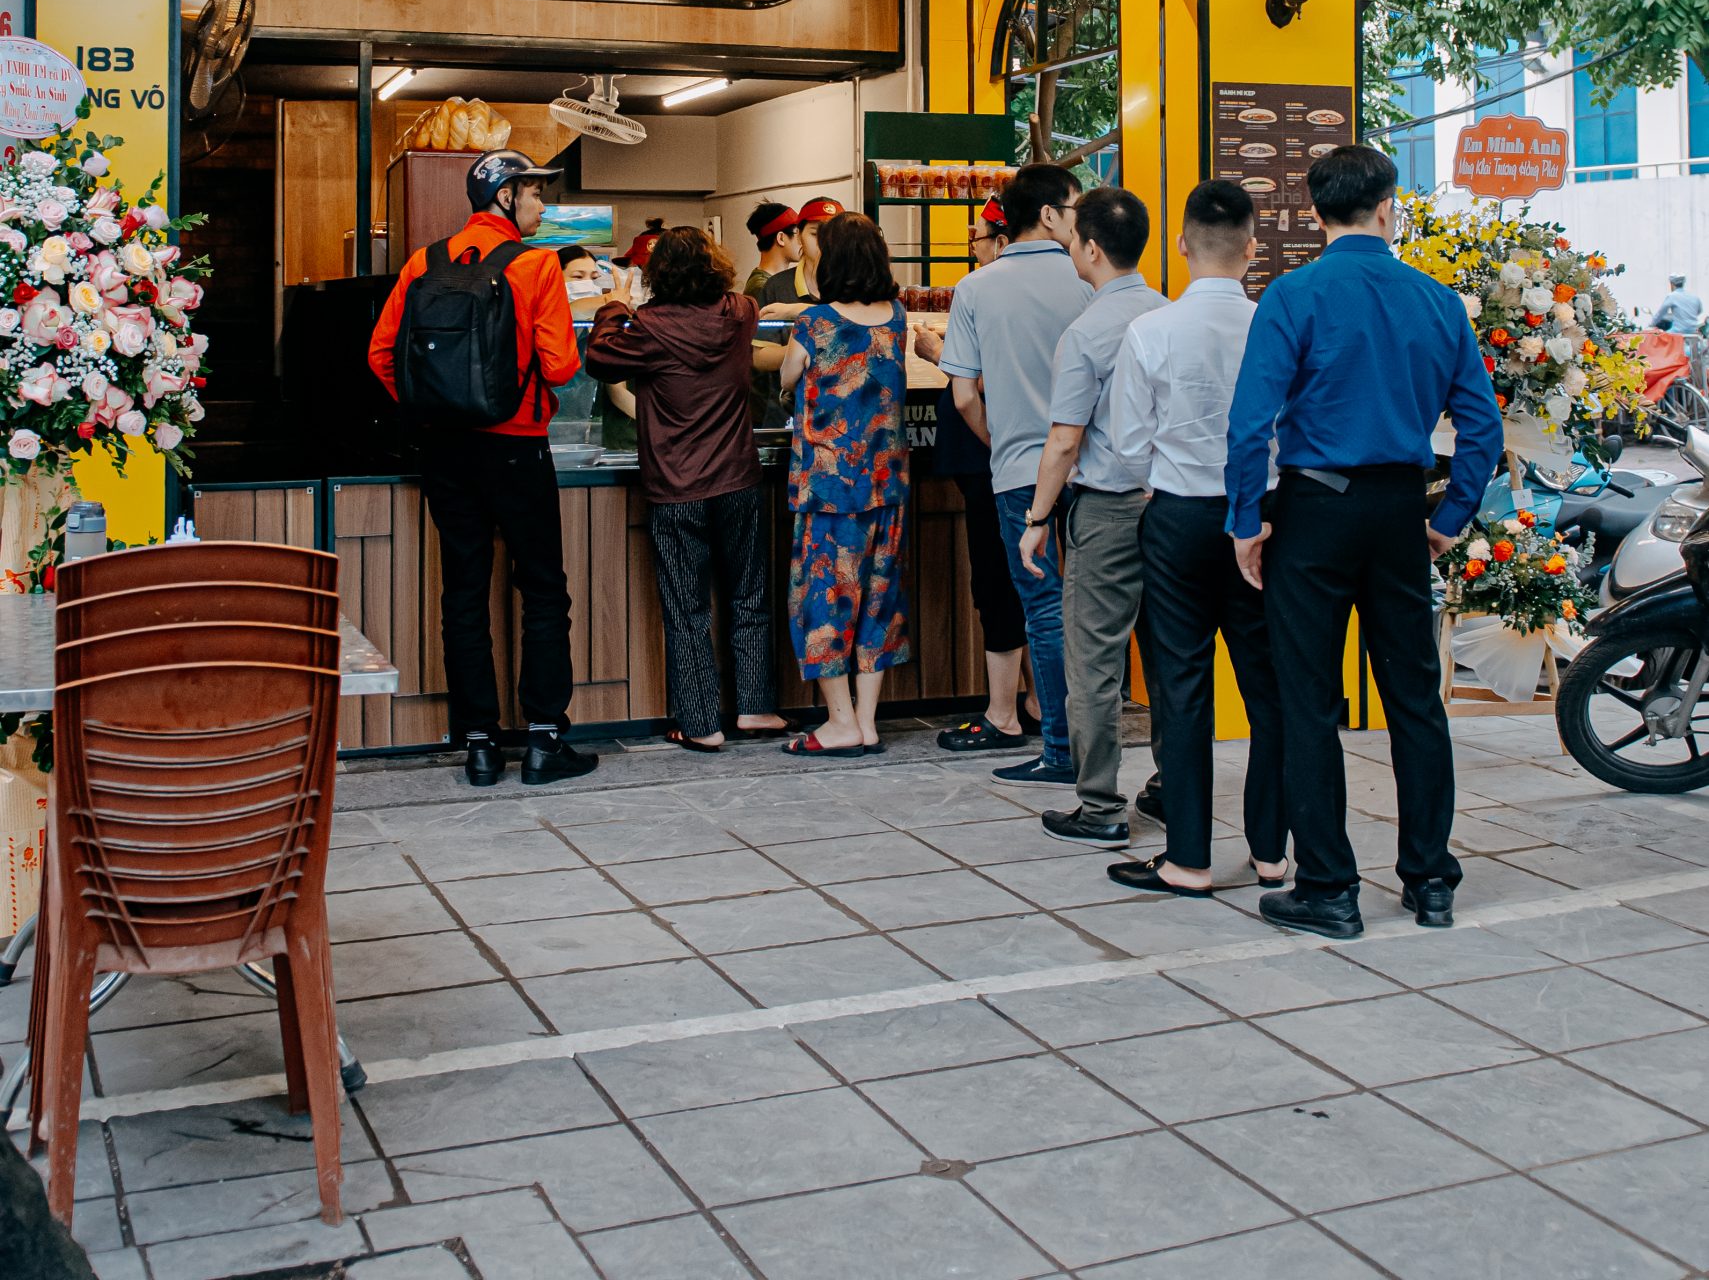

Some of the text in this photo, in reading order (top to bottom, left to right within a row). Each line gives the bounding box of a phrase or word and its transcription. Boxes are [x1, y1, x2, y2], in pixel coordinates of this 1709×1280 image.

[76, 45, 135, 72] 183
[9, 81, 32, 98] Smile
[34, 84, 46, 100] An
[48, 86, 67, 102] Sinh
[131, 84, 166, 110] VÕ
[1463, 136, 1561, 156] Em Minh Anh
